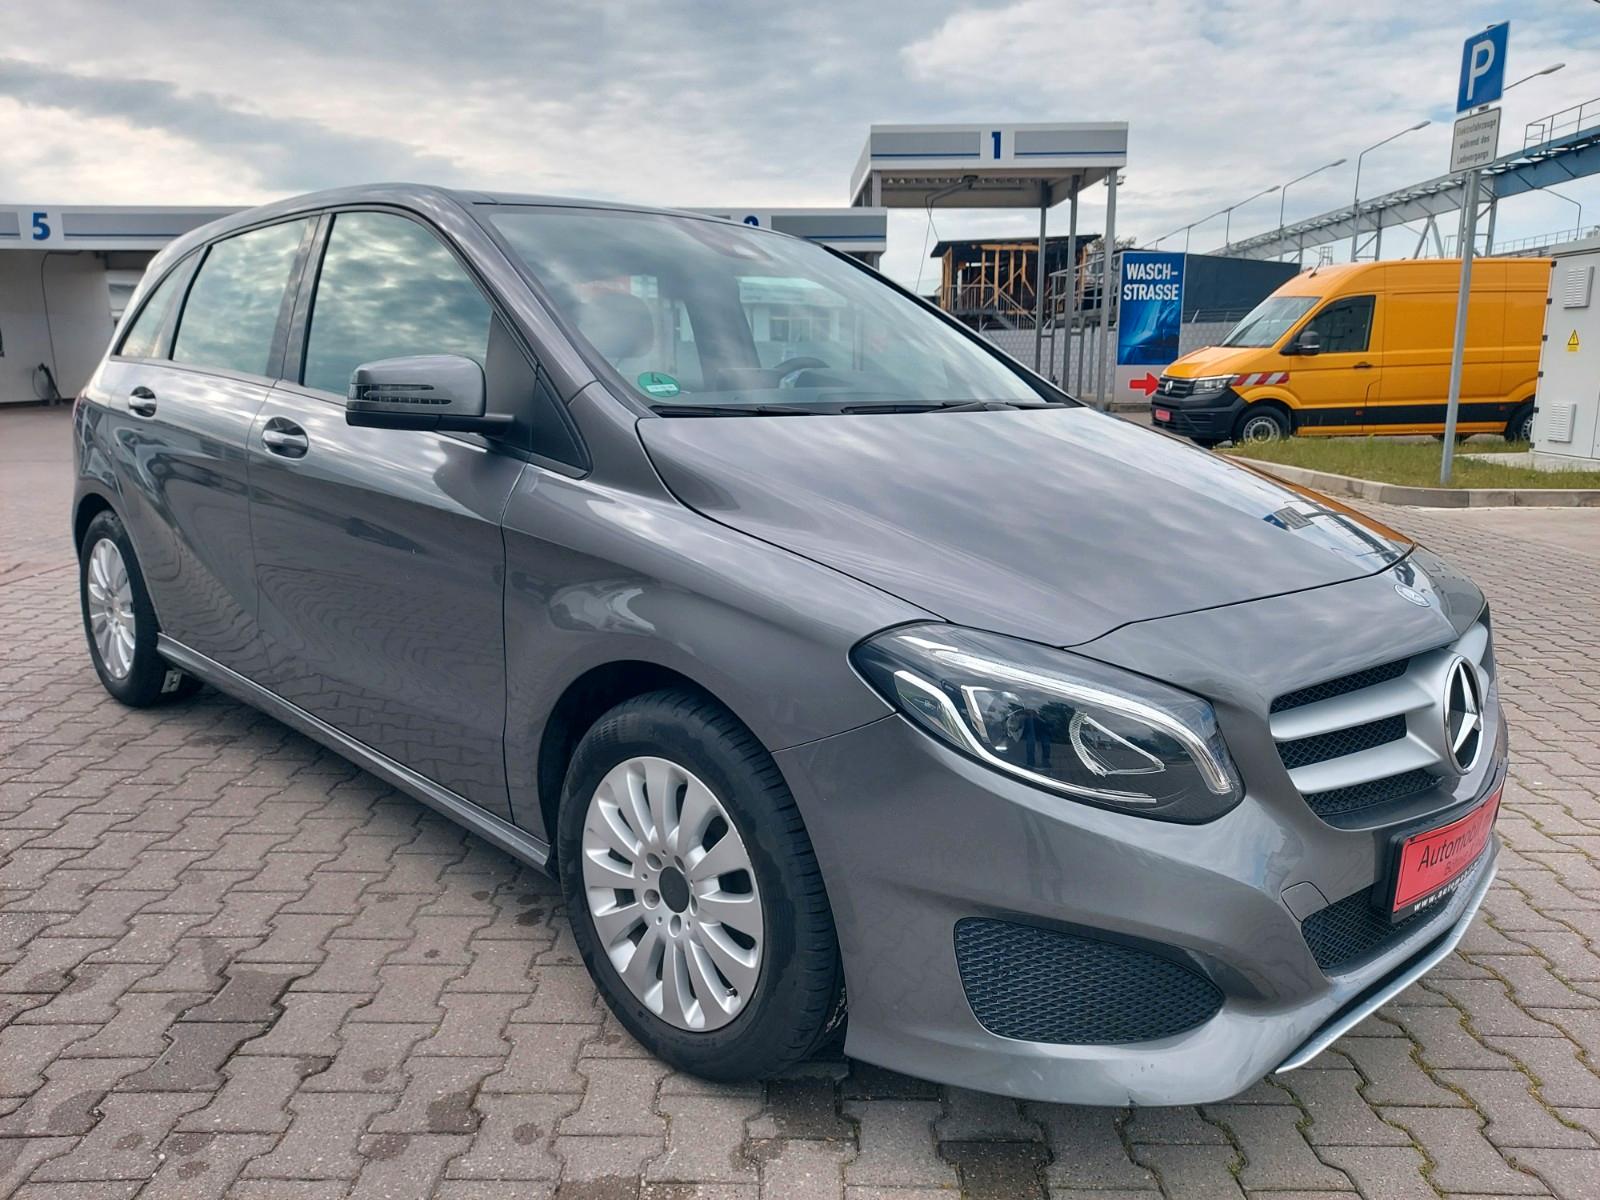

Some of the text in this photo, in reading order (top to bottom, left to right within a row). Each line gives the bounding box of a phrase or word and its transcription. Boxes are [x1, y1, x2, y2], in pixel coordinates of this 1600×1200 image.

[1466, 39, 1496, 101] P
[991, 131, 1002, 160] 1
[32, 211, 51, 242] 5
[1126, 262, 1179, 281] WASCH-
[1123, 283, 1180, 301] STRASSE
